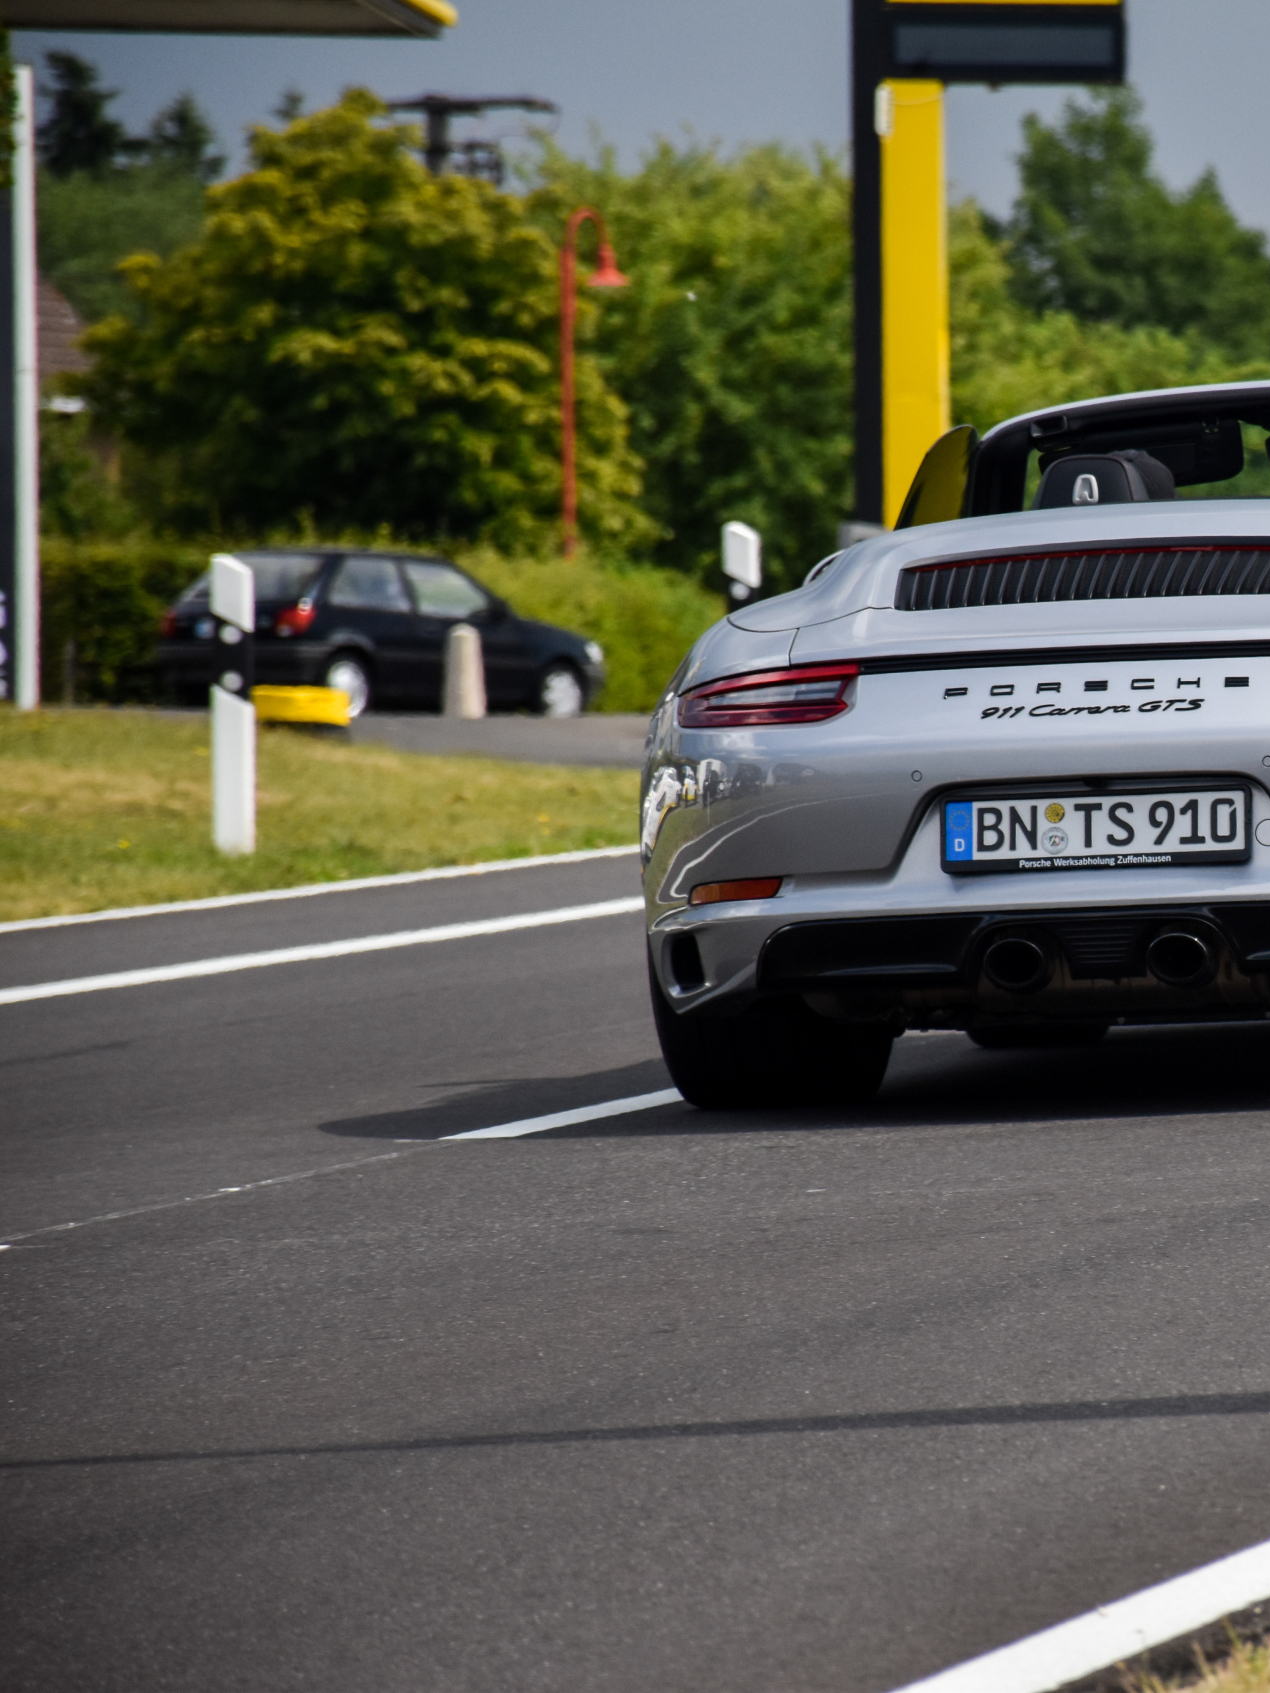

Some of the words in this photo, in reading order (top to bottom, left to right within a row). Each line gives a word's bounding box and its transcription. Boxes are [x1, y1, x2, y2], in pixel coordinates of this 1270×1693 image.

[944, 677, 1249, 699] PORSCHE
[981, 706, 1025, 719] 911
[1029, 704, 1130, 717] Carrera
[1138, 699, 1205, 712] GTS
[977, 805, 1038, 852] BN
[1074, 802, 1135, 848] TS
[1149, 798, 1238, 845] 910
[954, 838, 966, 852] D
[1019, 859, 1051, 868] Porsche
[1053, 856, 1115, 867] Werksabholung
[1117, 855, 1172, 864] Zuffenhausen
